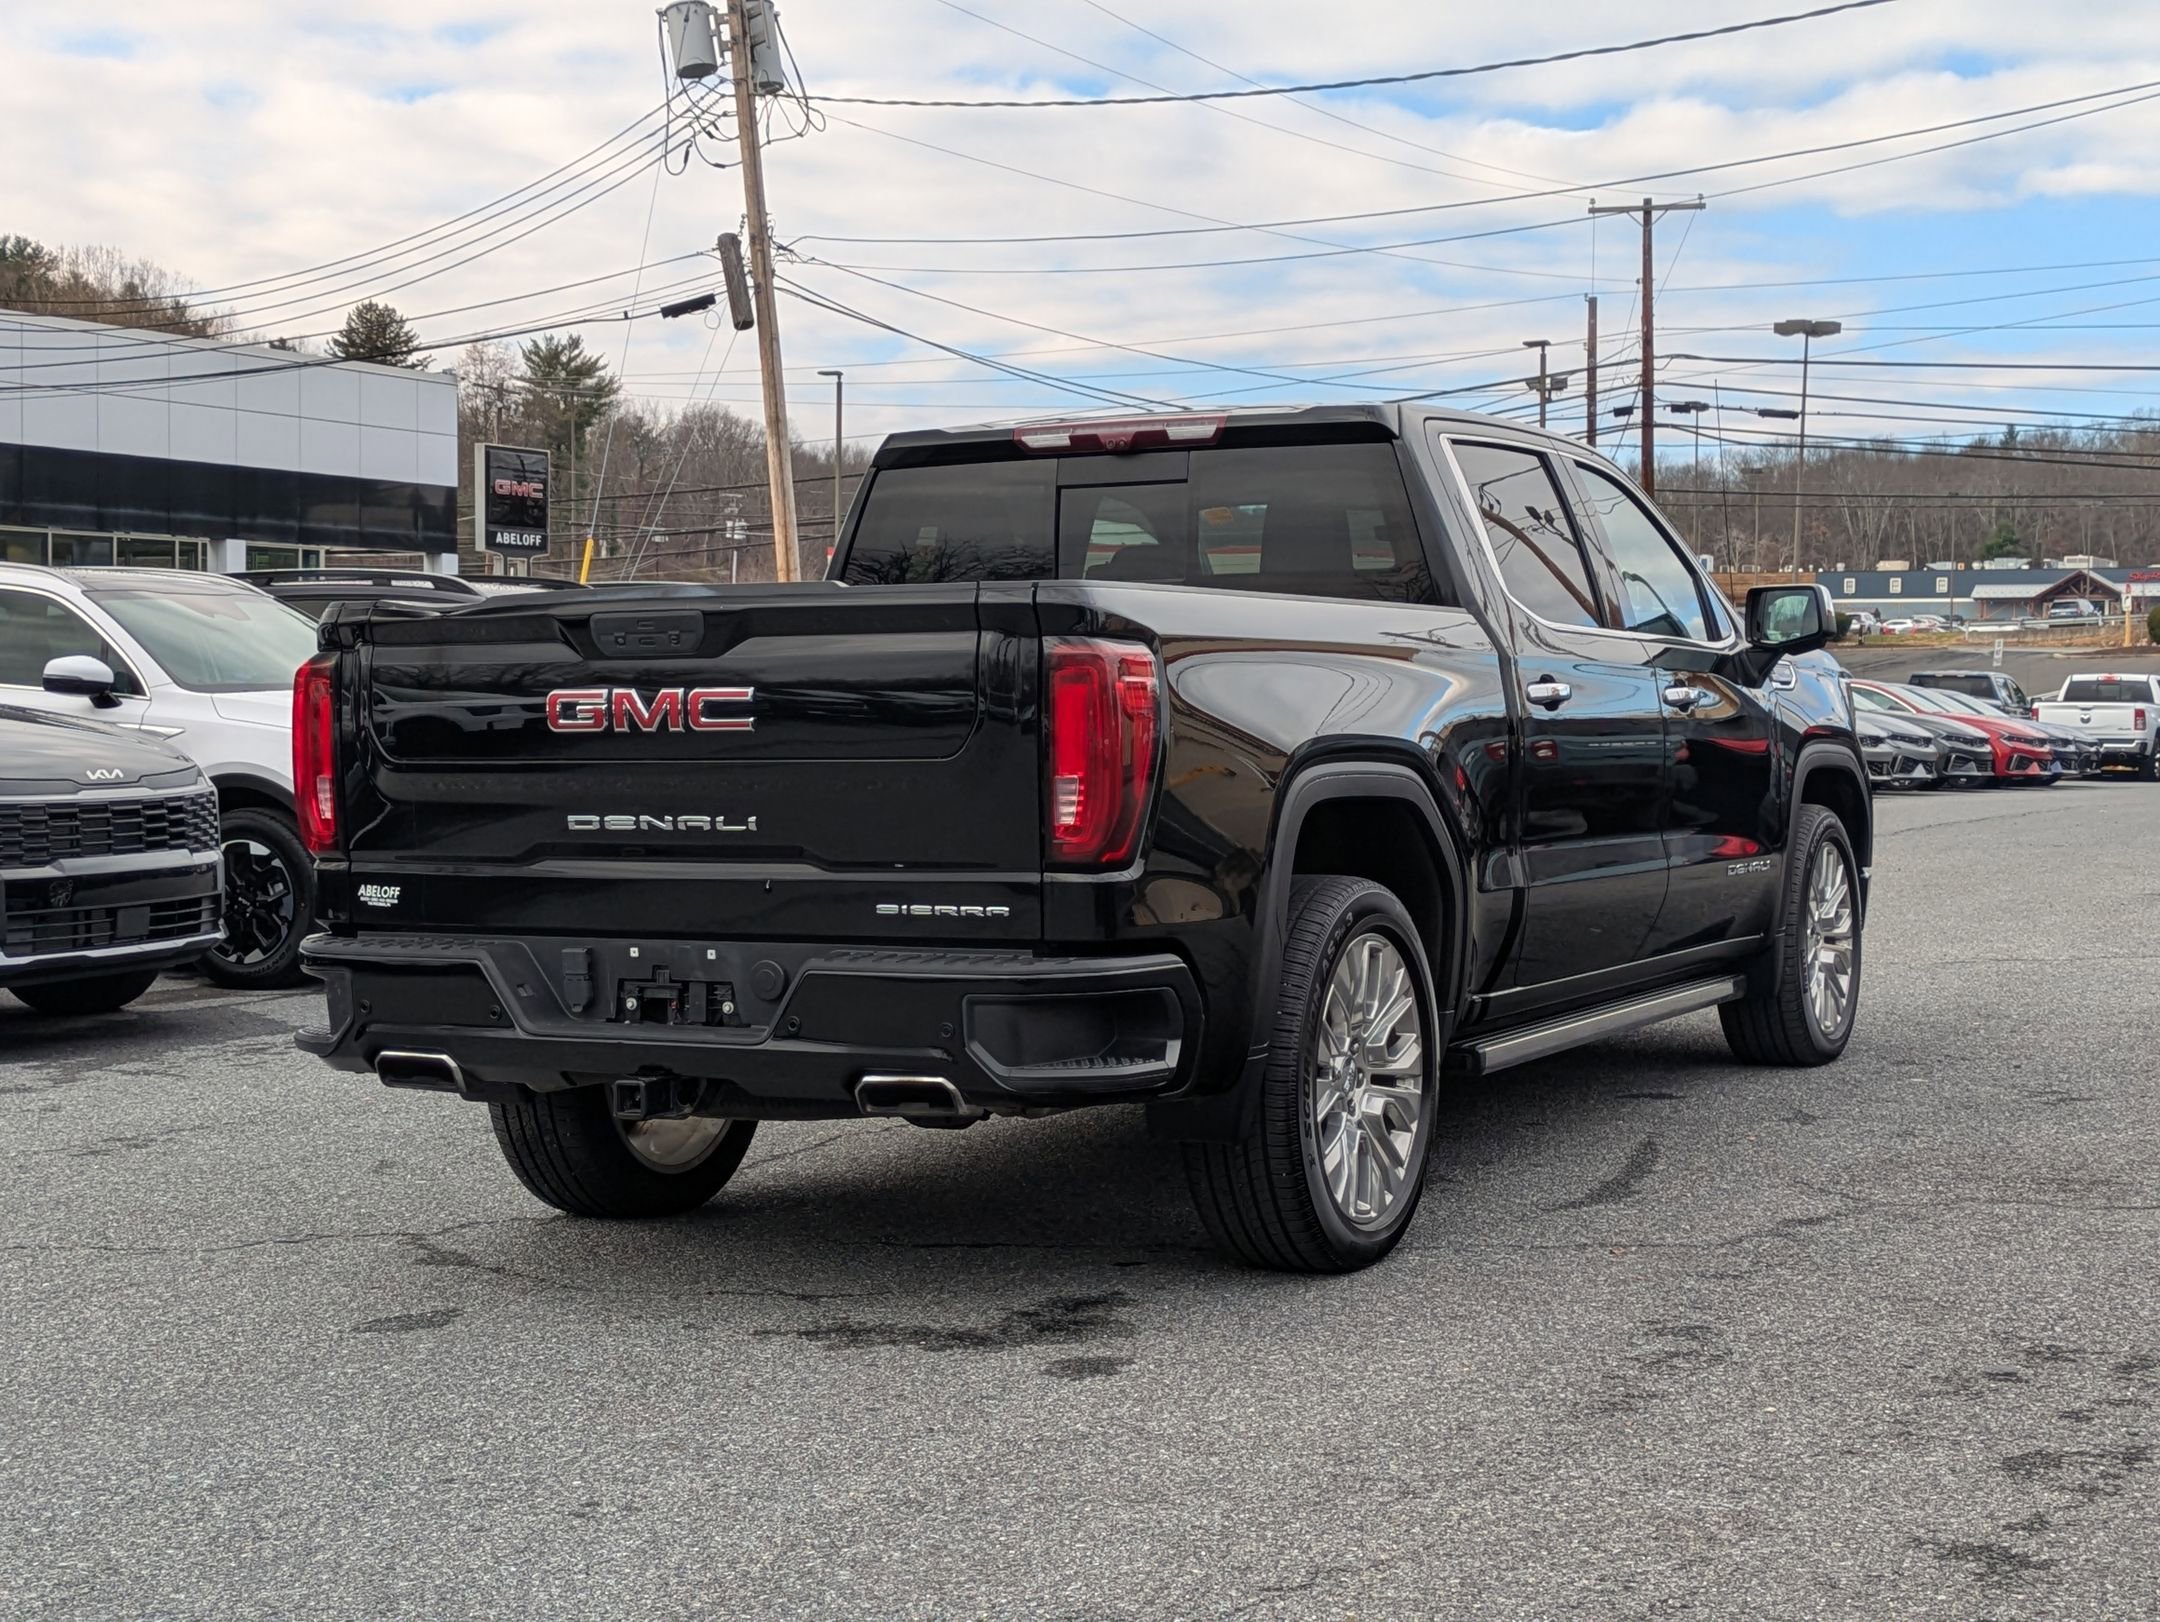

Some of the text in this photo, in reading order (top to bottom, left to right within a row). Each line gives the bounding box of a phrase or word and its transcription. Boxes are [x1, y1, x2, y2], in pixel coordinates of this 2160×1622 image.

[494, 479, 544, 498] GMC
[495, 531, 542, 546] ABELOFF
[546, 687, 756, 733] GMC
[86, 768, 124, 780] KIA
[567, 815, 758, 832] DENALI
[357, 884, 401, 899] ABELOFF
[875, 904, 1010, 917] SIERRA
[1303, 981, 1321, 1140] SCORON
